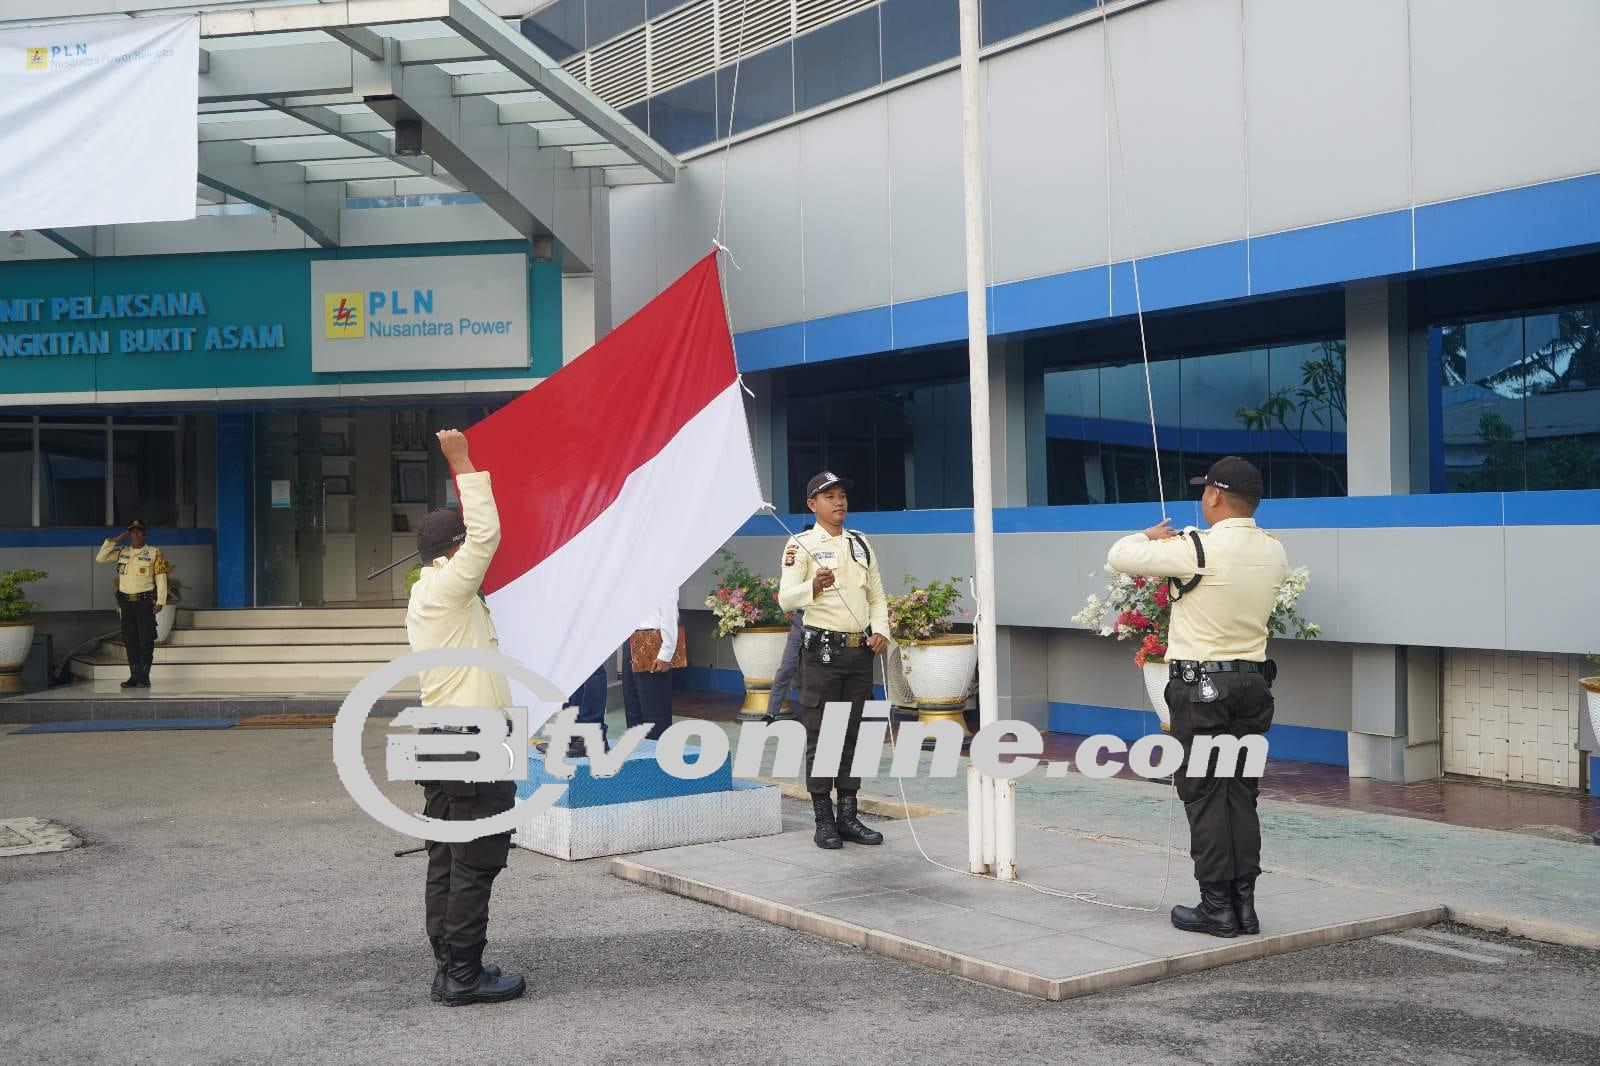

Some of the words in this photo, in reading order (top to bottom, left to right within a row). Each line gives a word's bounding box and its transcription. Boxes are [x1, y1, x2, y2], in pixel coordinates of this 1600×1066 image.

[51, 43, 87, 58] PLN
[51, 292, 207, 320] PELAKSANA
[369, 289, 433, 315] PLN
[119, 327, 196, 353] BUKIT
[204, 324, 285, 350] ASAM
[369, 320, 453, 337] Nusantara
[459, 318, 513, 335] Power
